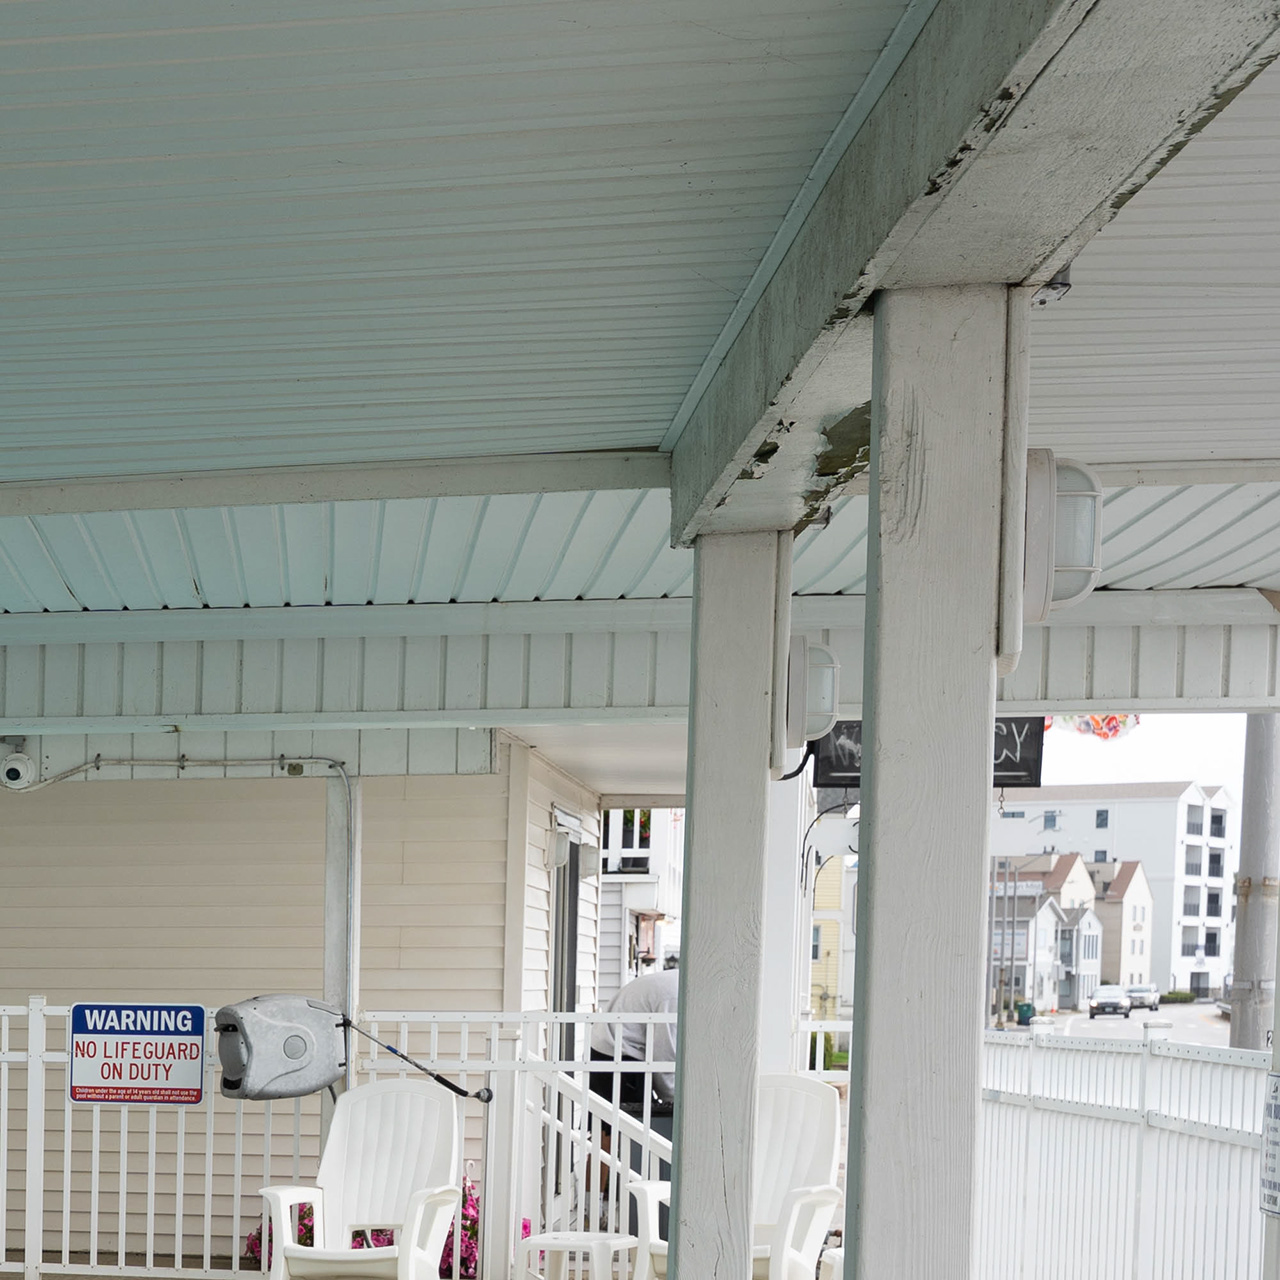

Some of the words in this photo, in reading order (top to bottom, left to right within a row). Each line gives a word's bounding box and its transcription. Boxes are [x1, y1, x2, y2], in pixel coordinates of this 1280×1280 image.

[85, 1009, 192, 1032] WARNING
[75, 1041, 97, 1058] NO
[104, 1041, 200, 1060] LIFEGUARD
[101, 1062, 123, 1080] ON
[129, 1063, 173, 1081] DUTY
